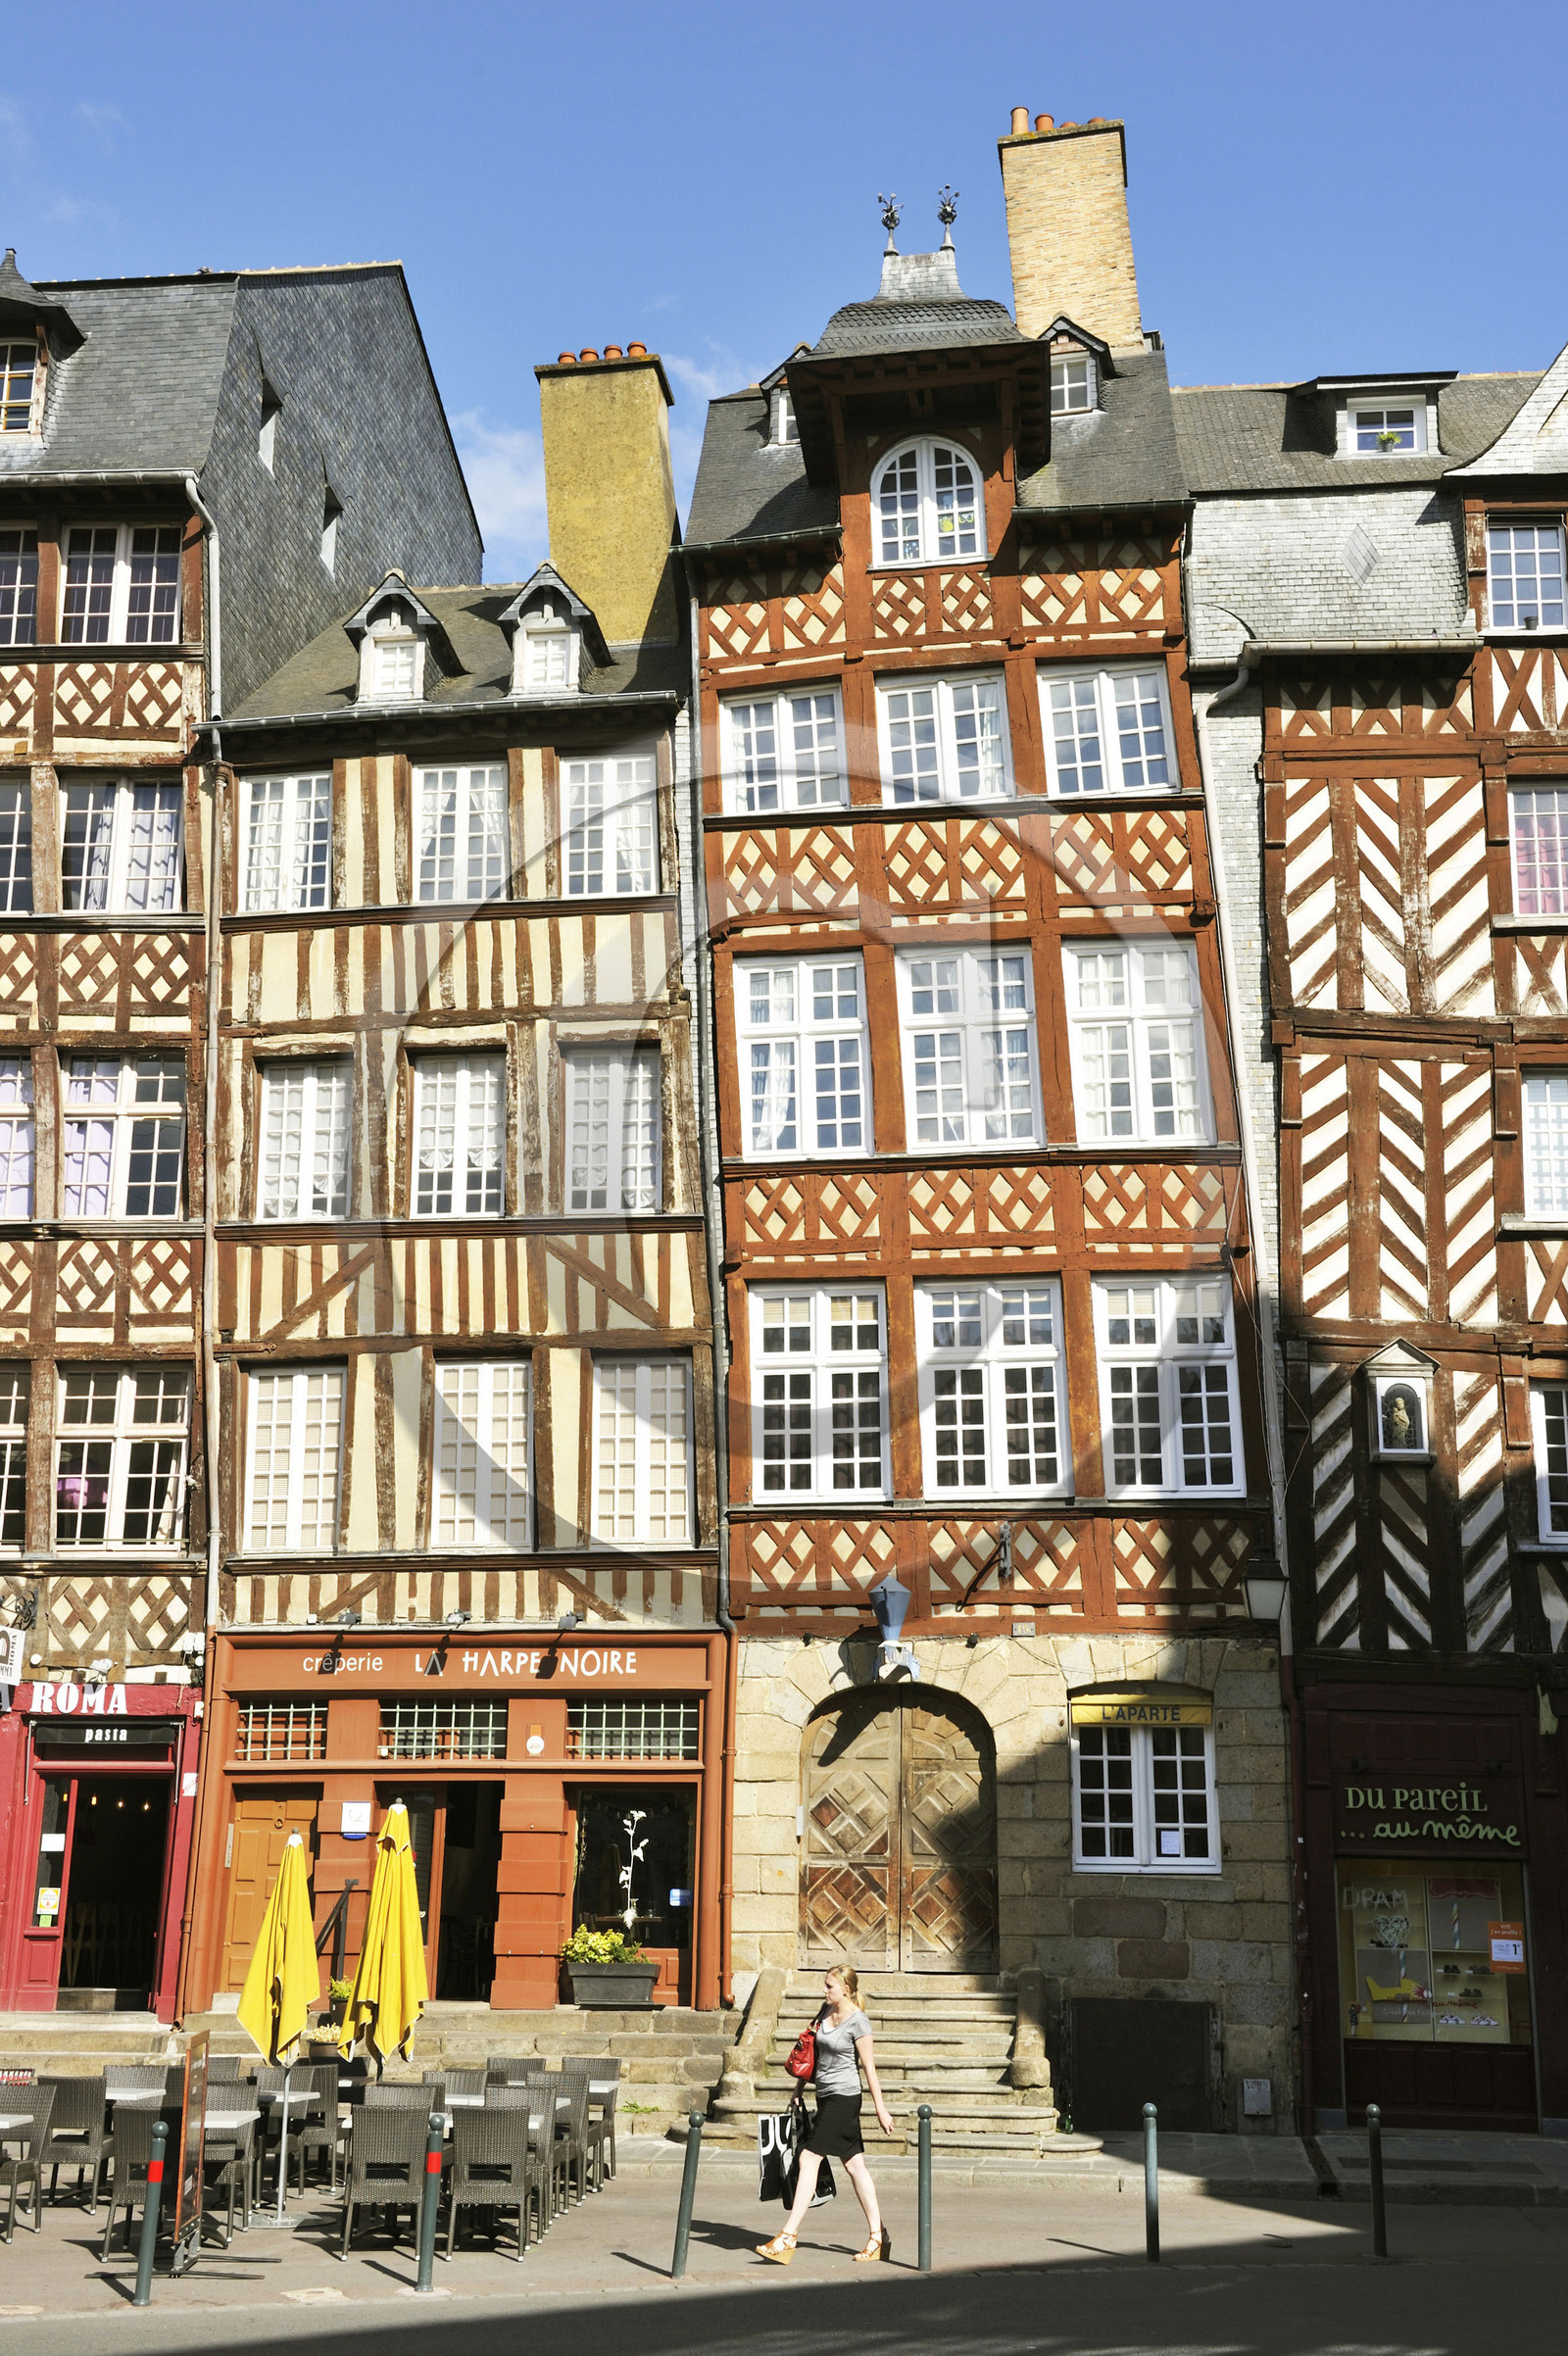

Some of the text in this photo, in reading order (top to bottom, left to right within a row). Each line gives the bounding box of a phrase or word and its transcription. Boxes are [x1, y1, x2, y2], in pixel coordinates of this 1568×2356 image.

[303, 1649, 637, 1678] crêperie LA HARPE NOIRE
[29, 1682, 127, 1714] ROMA
[1102, 1704, 1181, 1722] L'APARTÉ
[84, 1728, 127, 1743] pasta
[1422, 1814, 1521, 1846] même
[1343, 1886, 1408, 1911] DPAM
